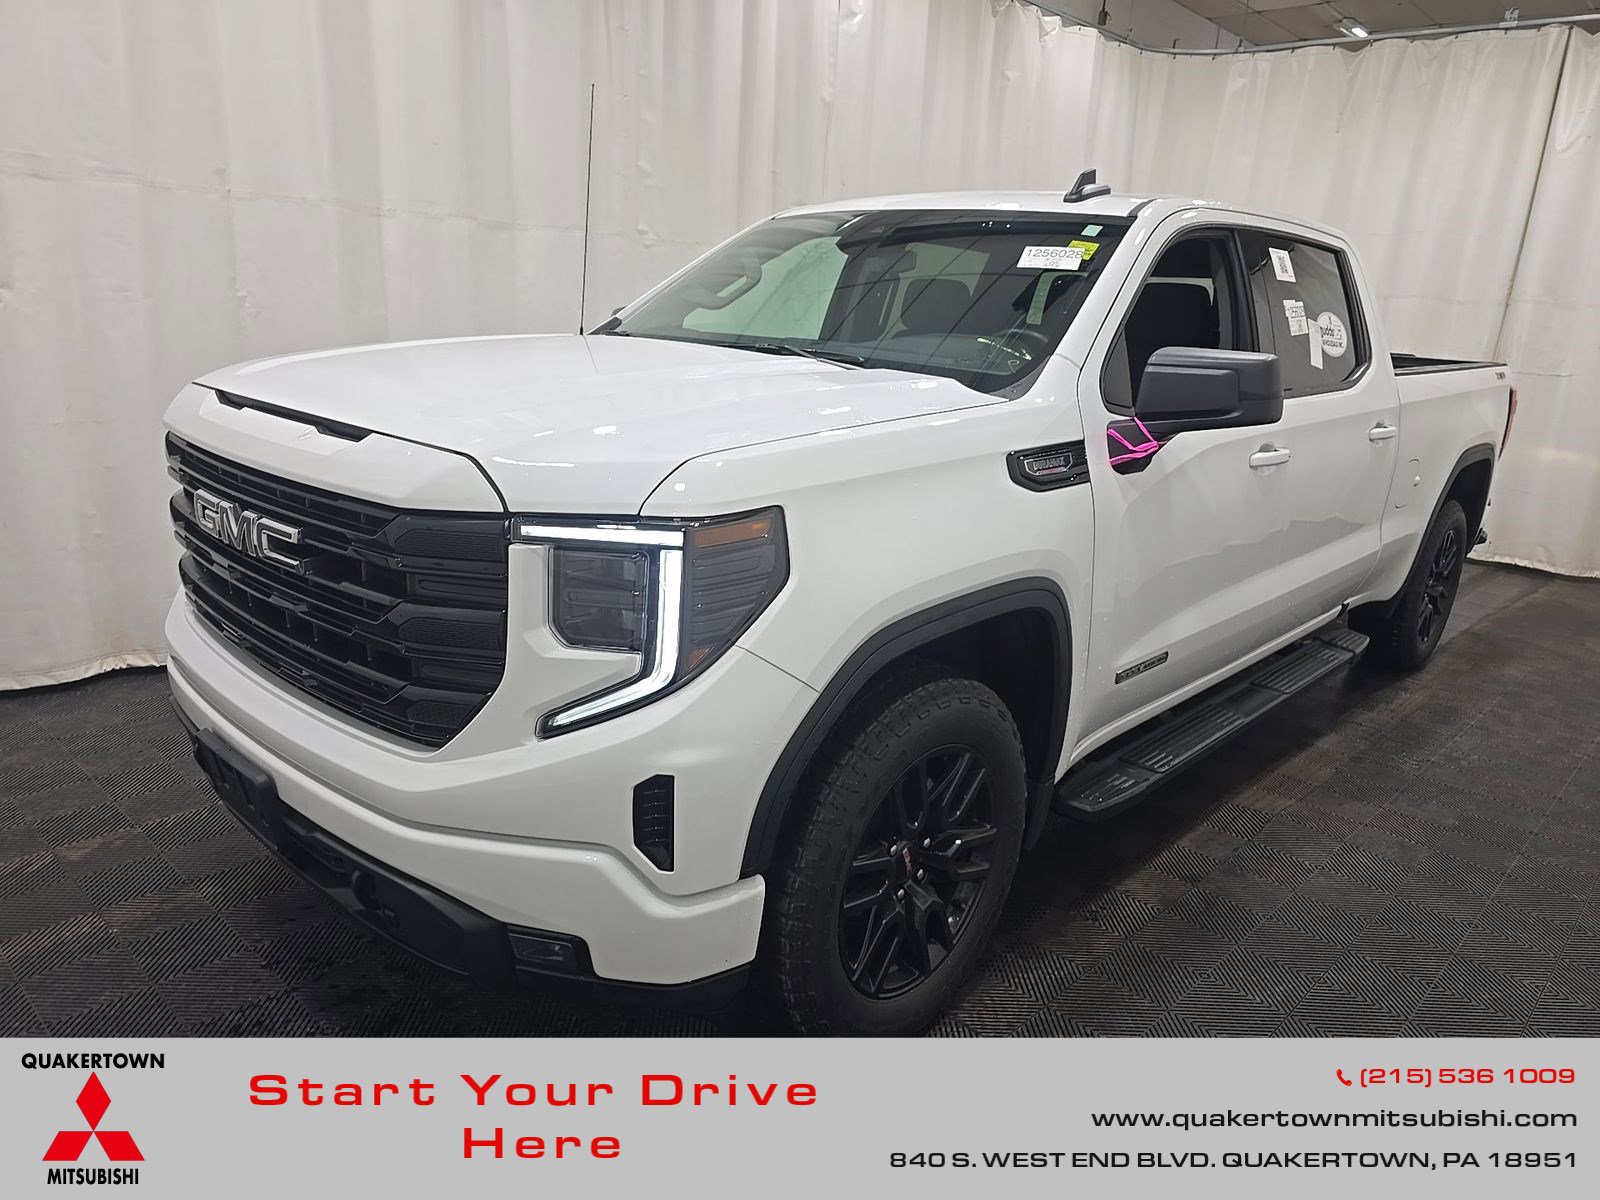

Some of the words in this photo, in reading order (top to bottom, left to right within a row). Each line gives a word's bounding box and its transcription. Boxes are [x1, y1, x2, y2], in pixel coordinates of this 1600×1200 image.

[1027, 248, 1085, 259] 1256028
[1032, 456, 1066, 470] DURAMAX
[193, 488, 304, 575] GMC
